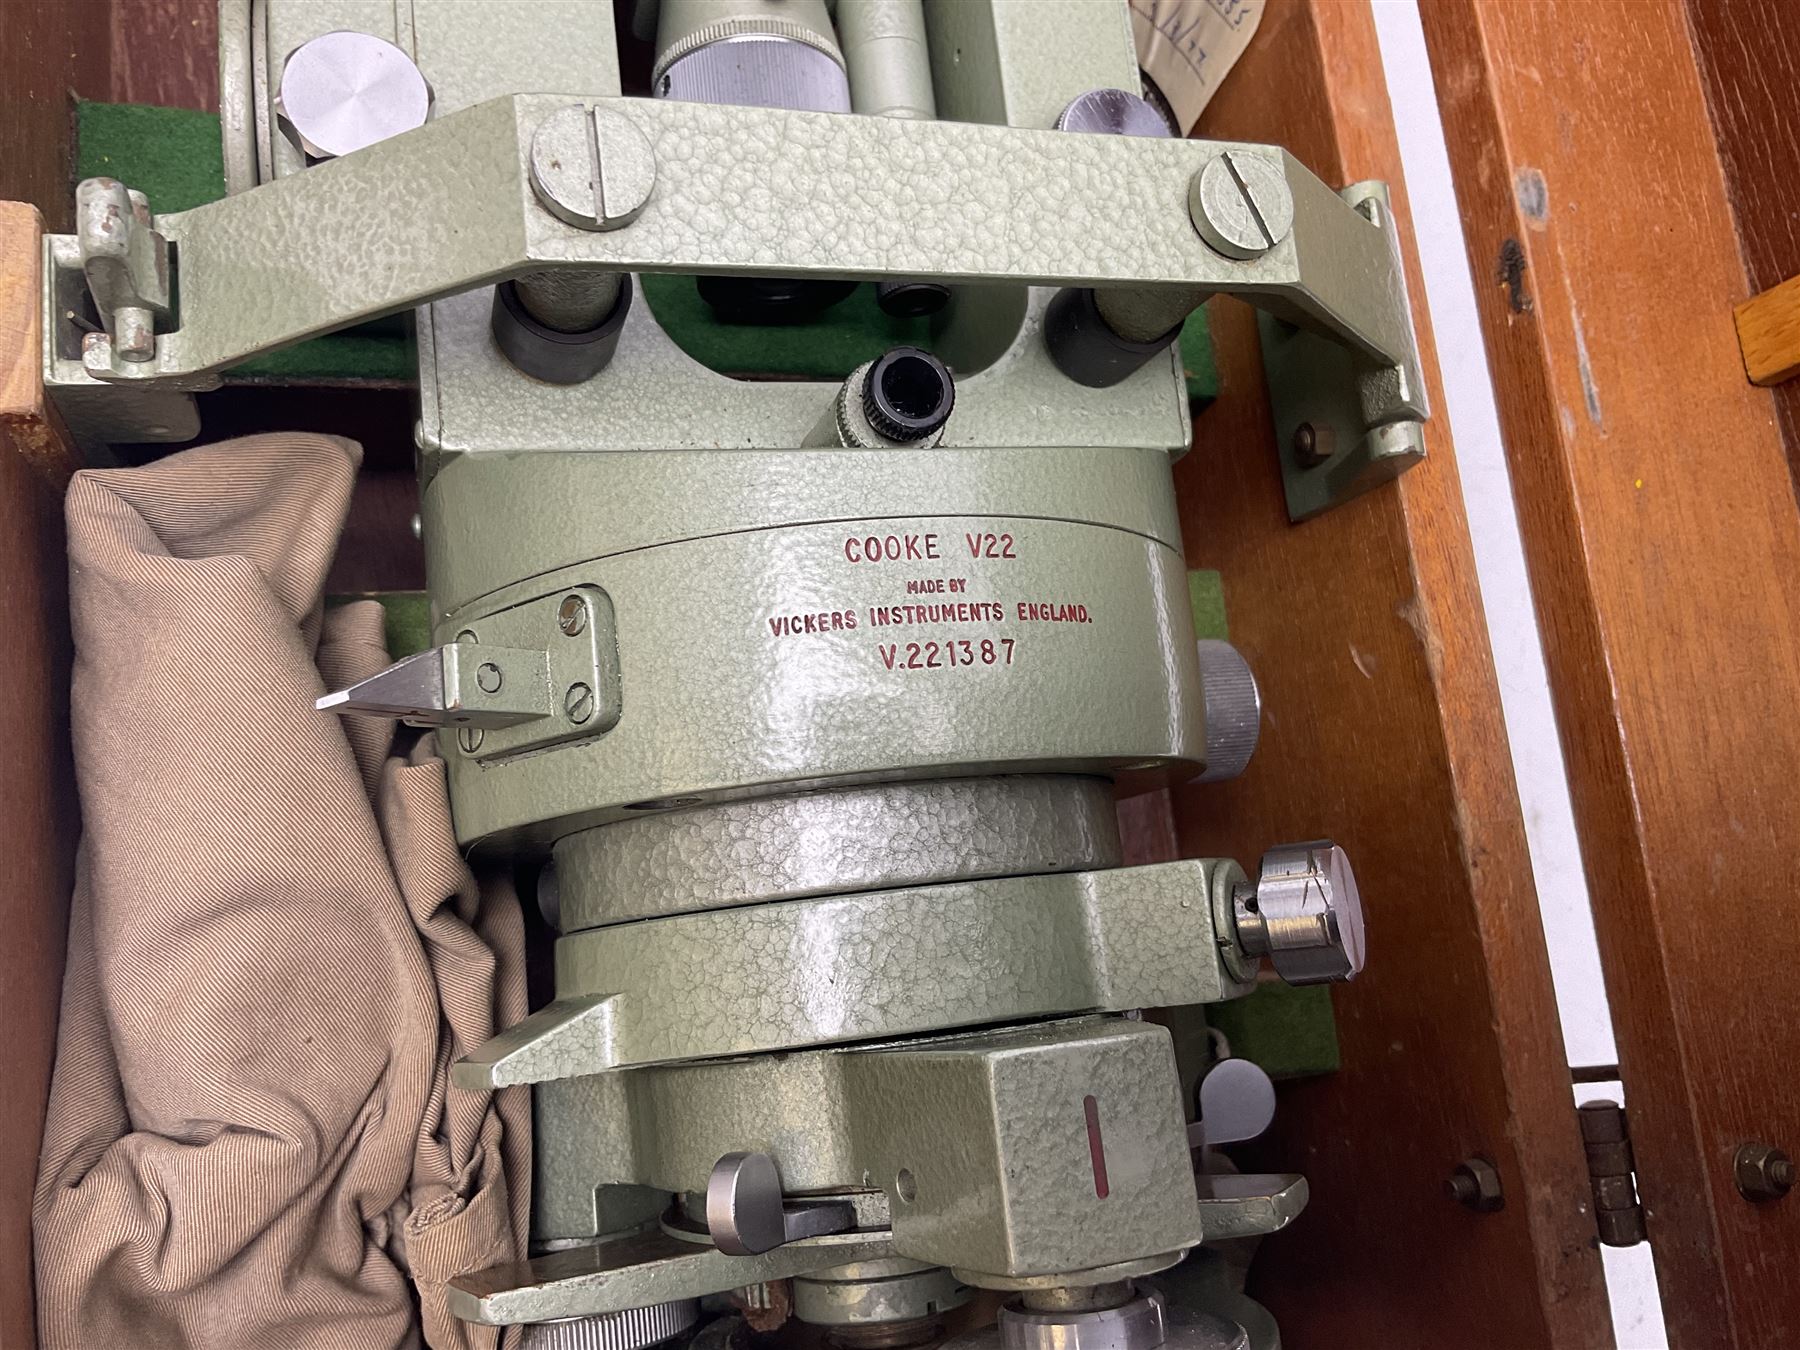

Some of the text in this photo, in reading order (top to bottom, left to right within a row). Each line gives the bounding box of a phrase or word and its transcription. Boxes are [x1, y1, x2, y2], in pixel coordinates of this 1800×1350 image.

[845, 533, 1017, 563] COOKE V22
[907, 578, 966, 594] MADE BY
[769, 602, 1093, 637] VICKERS INSTRUMENTS ENGLAND.
[879, 638, 1016, 670] V.221387
